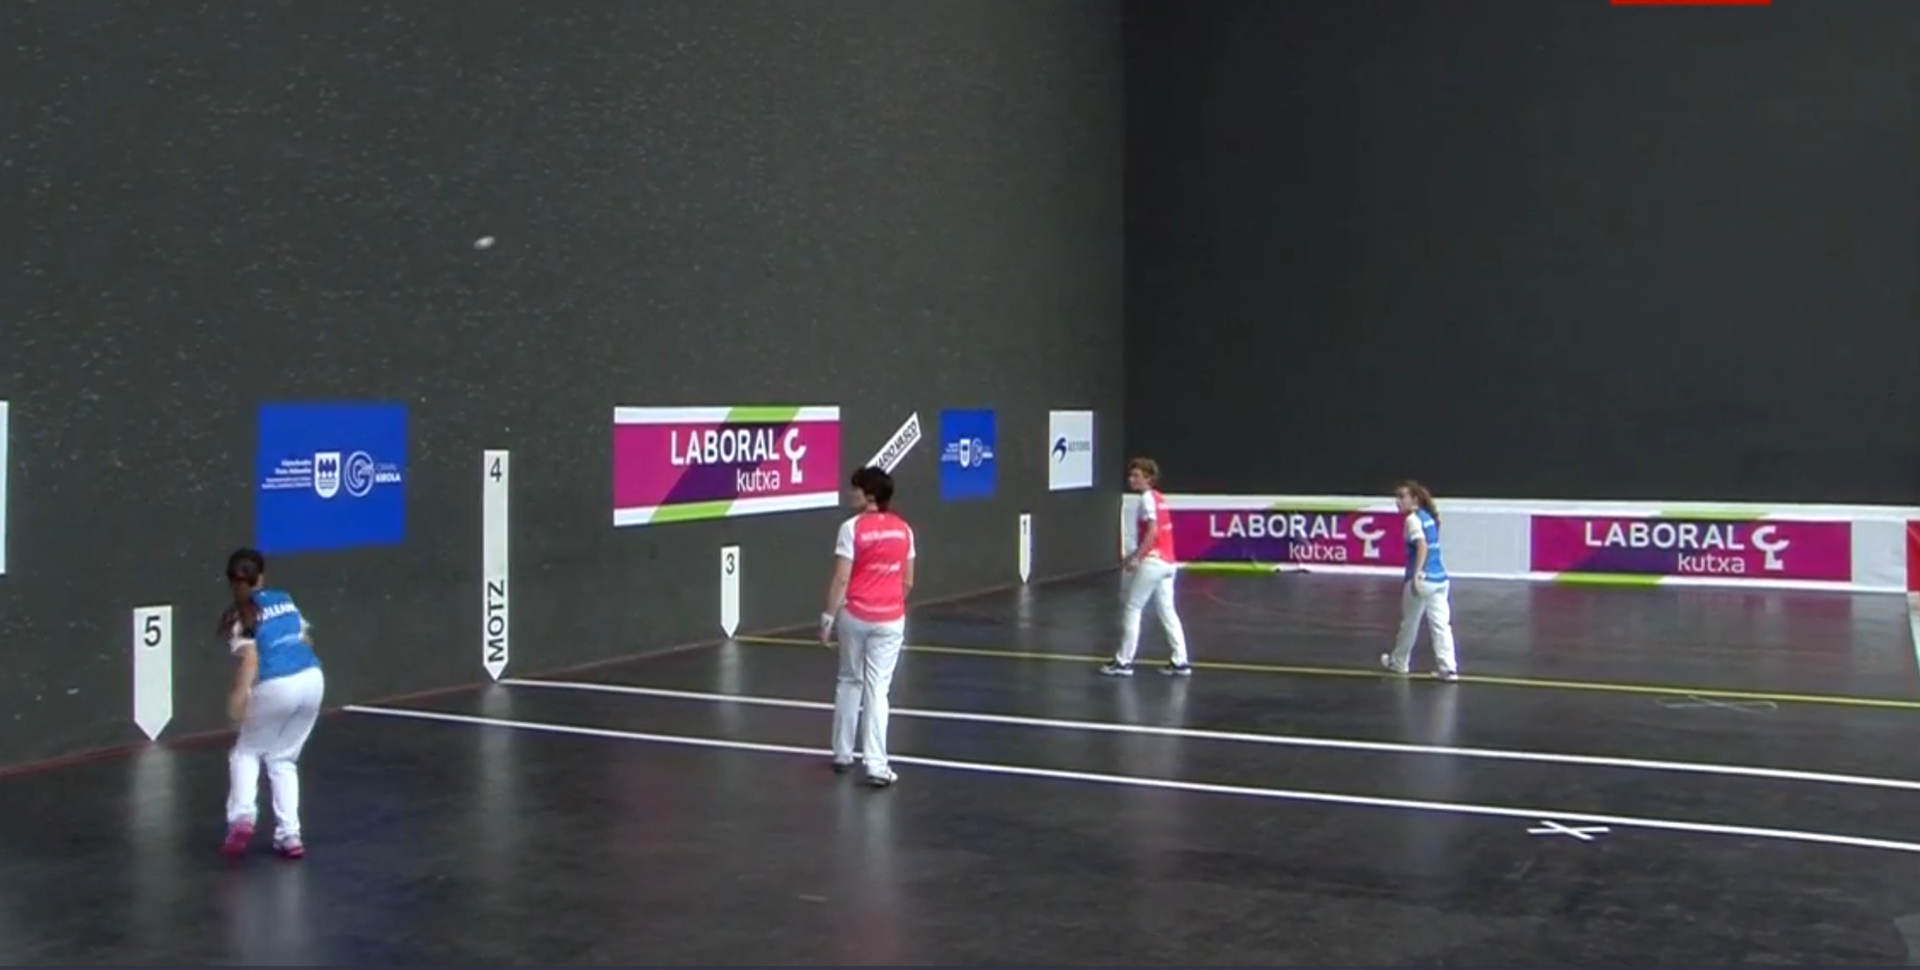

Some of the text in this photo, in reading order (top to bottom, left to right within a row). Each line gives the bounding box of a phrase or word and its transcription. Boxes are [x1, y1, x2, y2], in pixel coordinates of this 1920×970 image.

[670, 428, 780, 466] LABORAL
[490, 457, 502, 483] 4
[736, 468, 780, 492] kutxa
[1208, 513, 1347, 540] LABORAL
[1584, 521, 1745, 550] LABORAL
[726, 552, 735, 575] 3
[1288, 542, 1347, 562] kutxa
[1677, 552, 1746, 574] kutxa
[144, 615, 162, 647] 5
[487, 579, 504, 663] MOTZ
